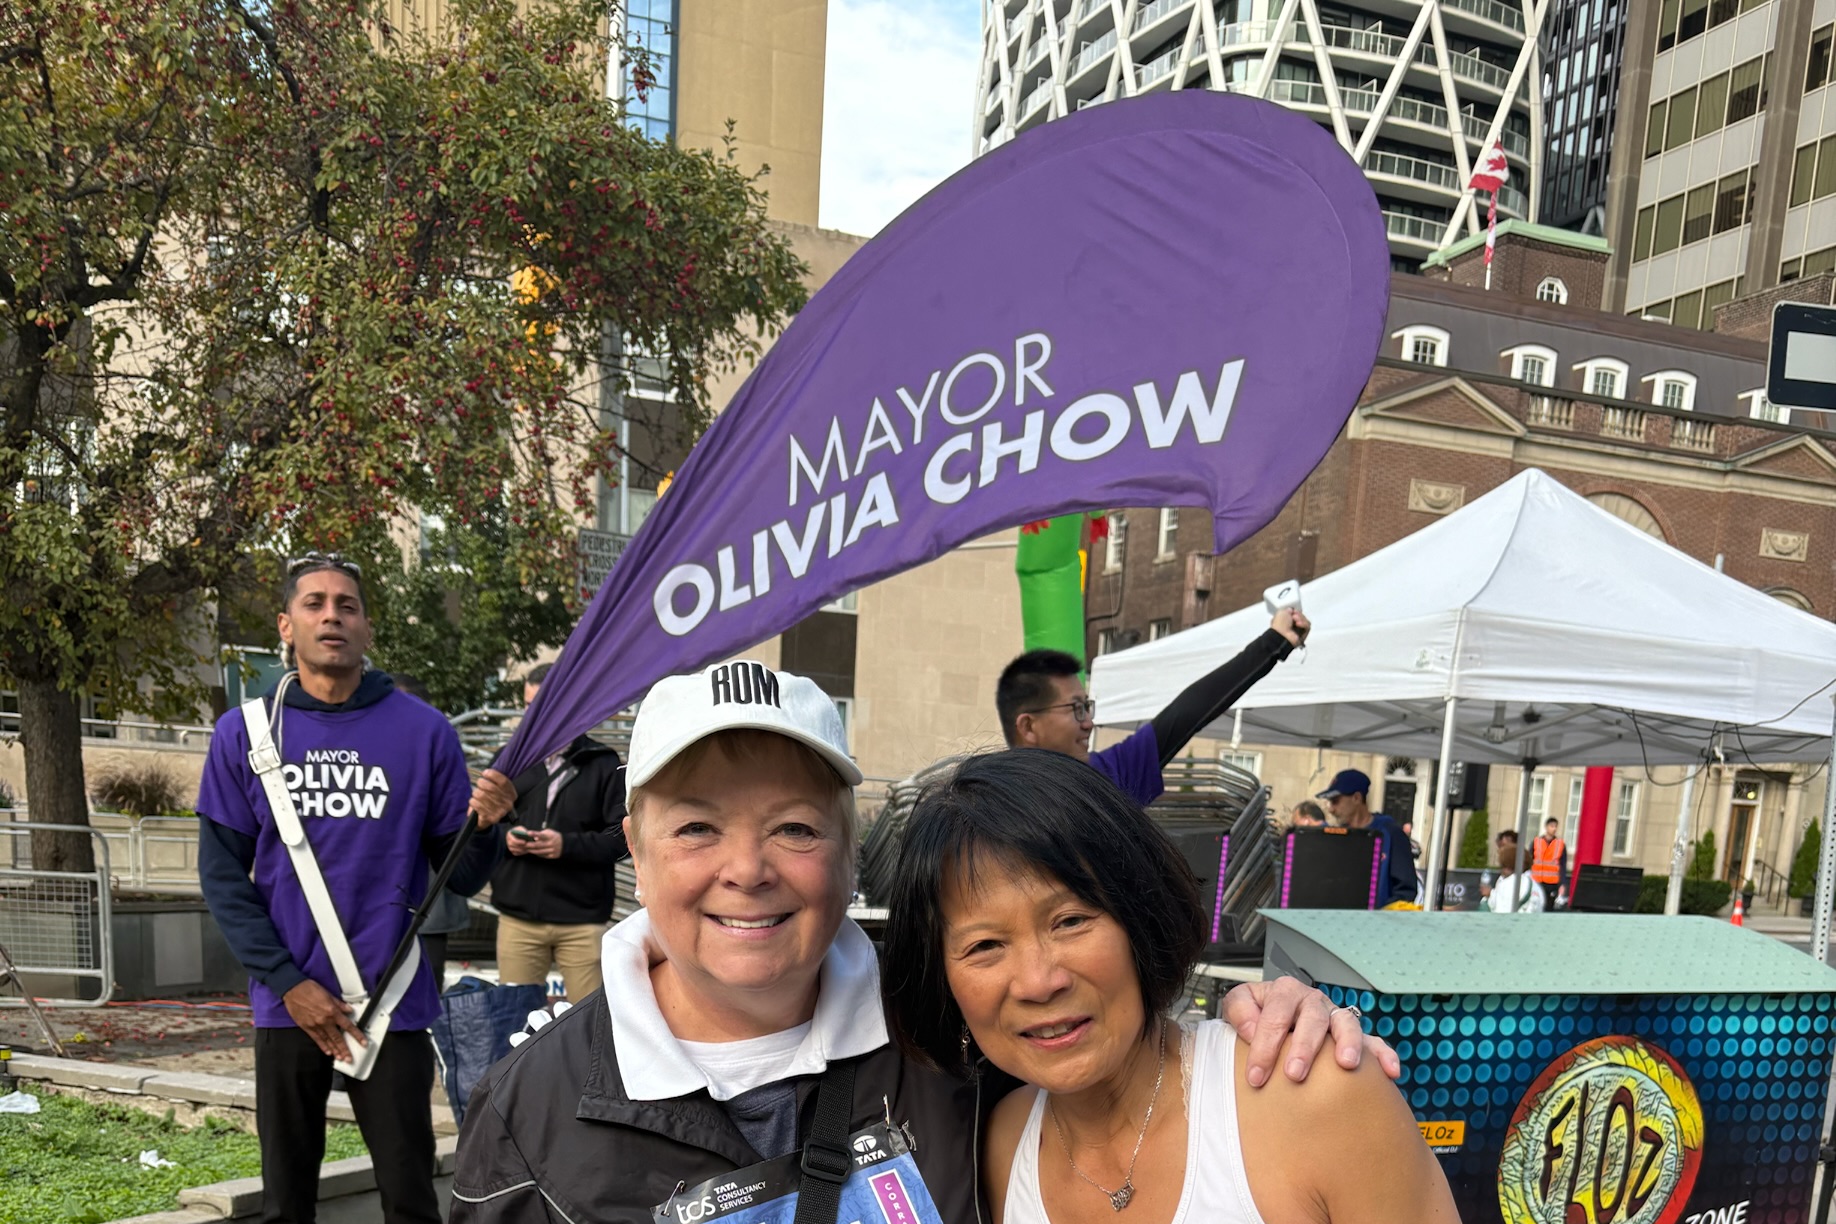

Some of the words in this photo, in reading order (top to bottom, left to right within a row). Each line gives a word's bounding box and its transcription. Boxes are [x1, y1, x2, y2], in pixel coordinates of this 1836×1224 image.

[787, 333, 1055, 507] MAYOR
[653, 471, 899, 636] OLIVIA
[923, 358, 1245, 504] CHOW
[711, 662, 781, 709] ROM
[305, 750, 359, 764] MAYOR
[281, 764, 390, 792] OLIVIA
[855, 1149, 887, 1166] TATA
[713, 1181, 738, 1194] TATA
[717, 1181, 766, 1203] CONSULTANCY
[676, 1195, 716, 1224] tcs
[720, 1194, 753, 1212] SERVICES
